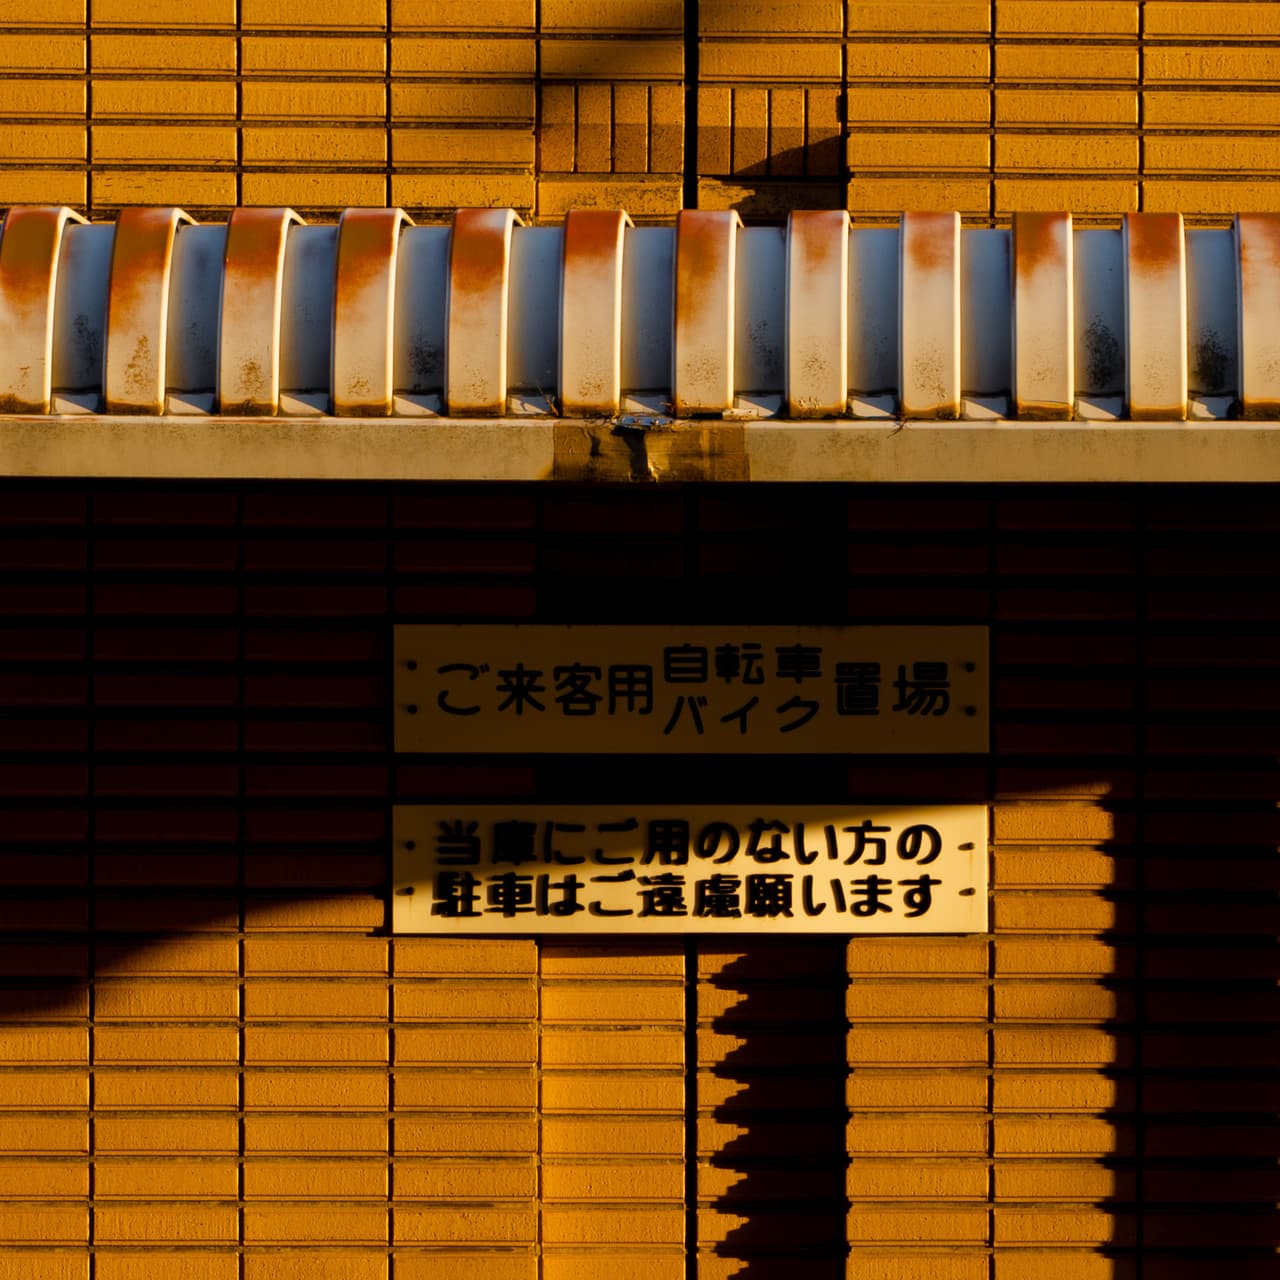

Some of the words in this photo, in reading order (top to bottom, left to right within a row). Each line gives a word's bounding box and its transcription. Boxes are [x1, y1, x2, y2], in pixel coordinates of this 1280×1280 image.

[663, 643, 823, 685] 自転車
[437, 661, 654, 717] ご来客用
[833, 661, 951, 717] 置場
[663, 695, 821, 735] バイク
[437, 818, 942, 866] 当庫にご用のない方の
[434, 869, 943, 917] 駐車はご遠慮願います
